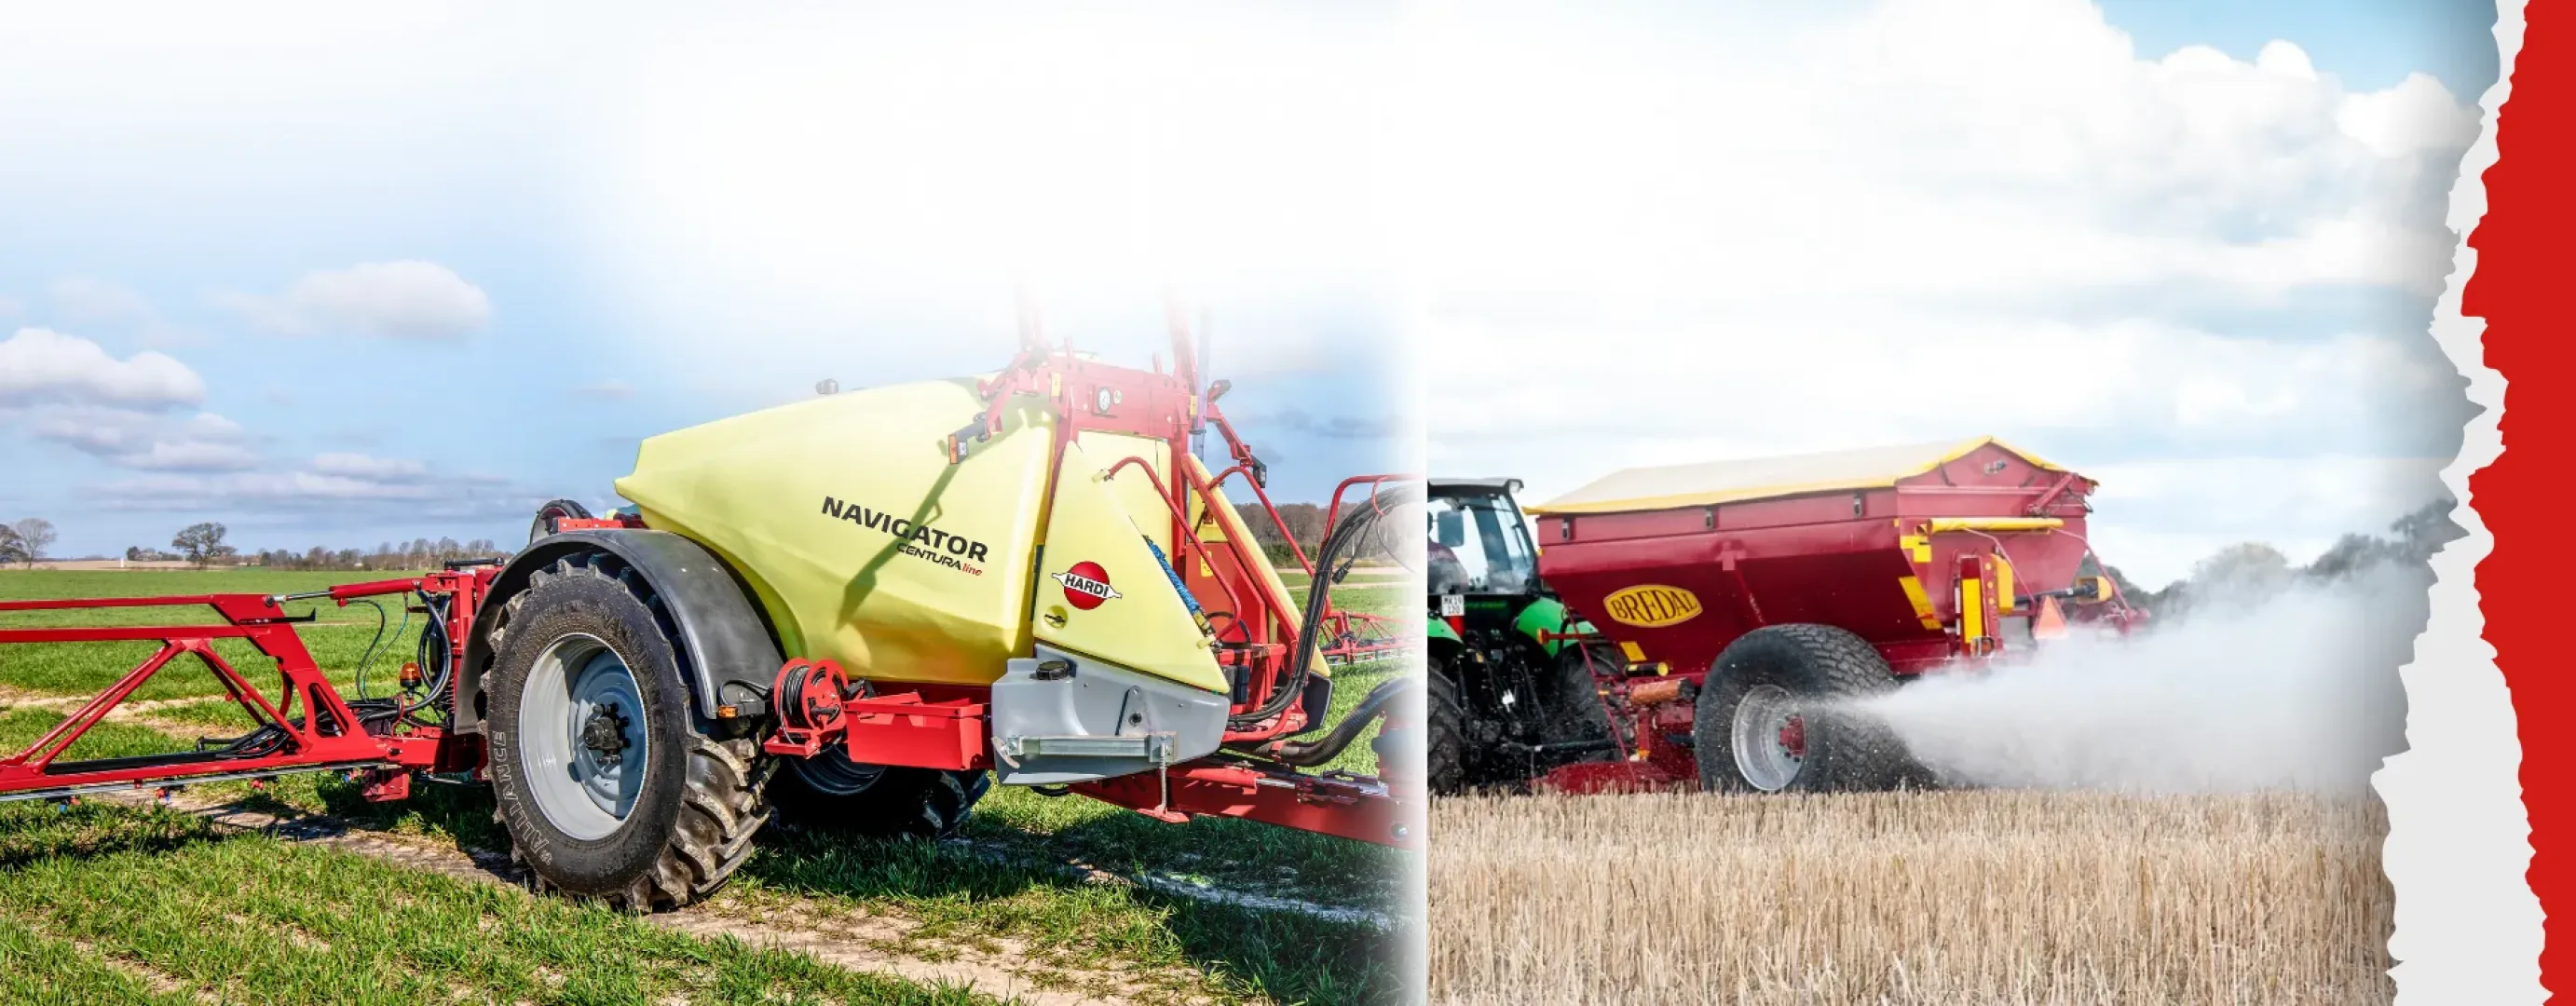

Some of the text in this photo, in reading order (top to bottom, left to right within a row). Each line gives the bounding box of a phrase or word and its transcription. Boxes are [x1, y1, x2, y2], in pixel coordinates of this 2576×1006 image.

[821, 496, 988, 563] NAVIGATOR
[1064, 574, 1110, 597] HARDI
[1610, 589, 1698, 623] BREDAL
[492, 730, 550, 854] ALLIANCE
